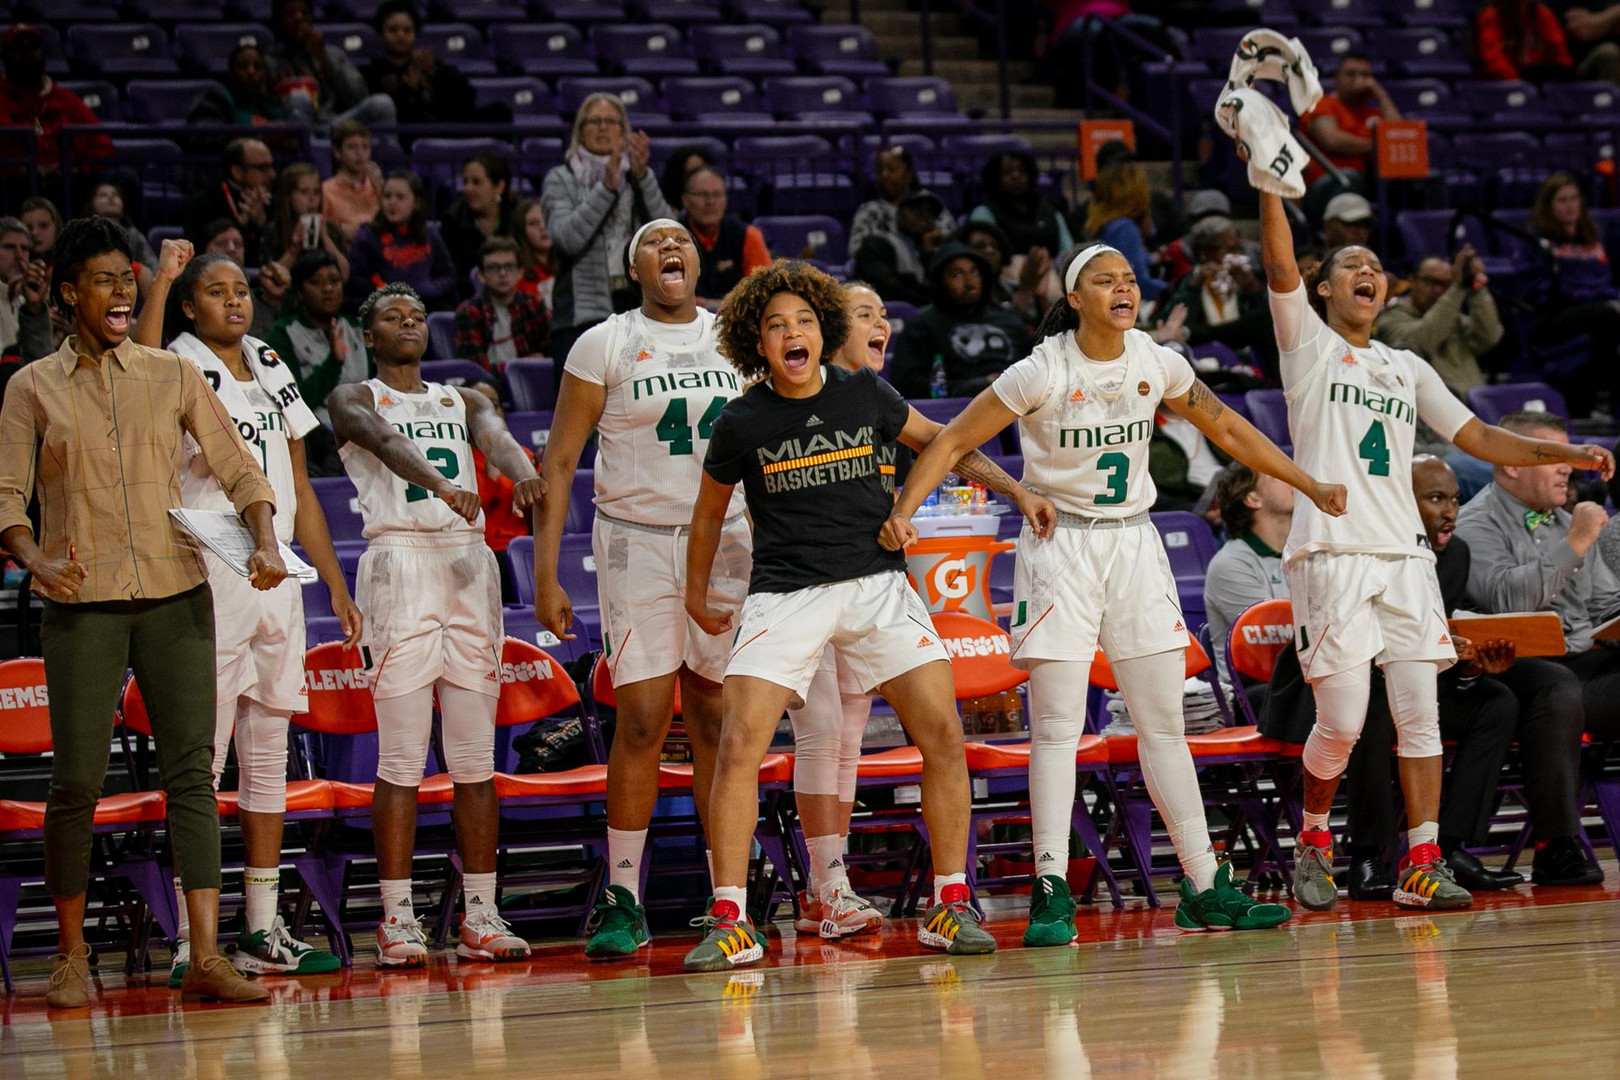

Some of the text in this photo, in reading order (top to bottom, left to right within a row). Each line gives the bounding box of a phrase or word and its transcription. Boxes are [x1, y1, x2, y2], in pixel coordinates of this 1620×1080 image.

[655, 396, 728, 456] 44
[757, 426, 874, 466] MIAMI
[1359, 418, 1390, 477] 4
[764, 455, 875, 494] BASKETBALL
[1093, 451, 1130, 505] 3
[934, 558, 969, 599] G
